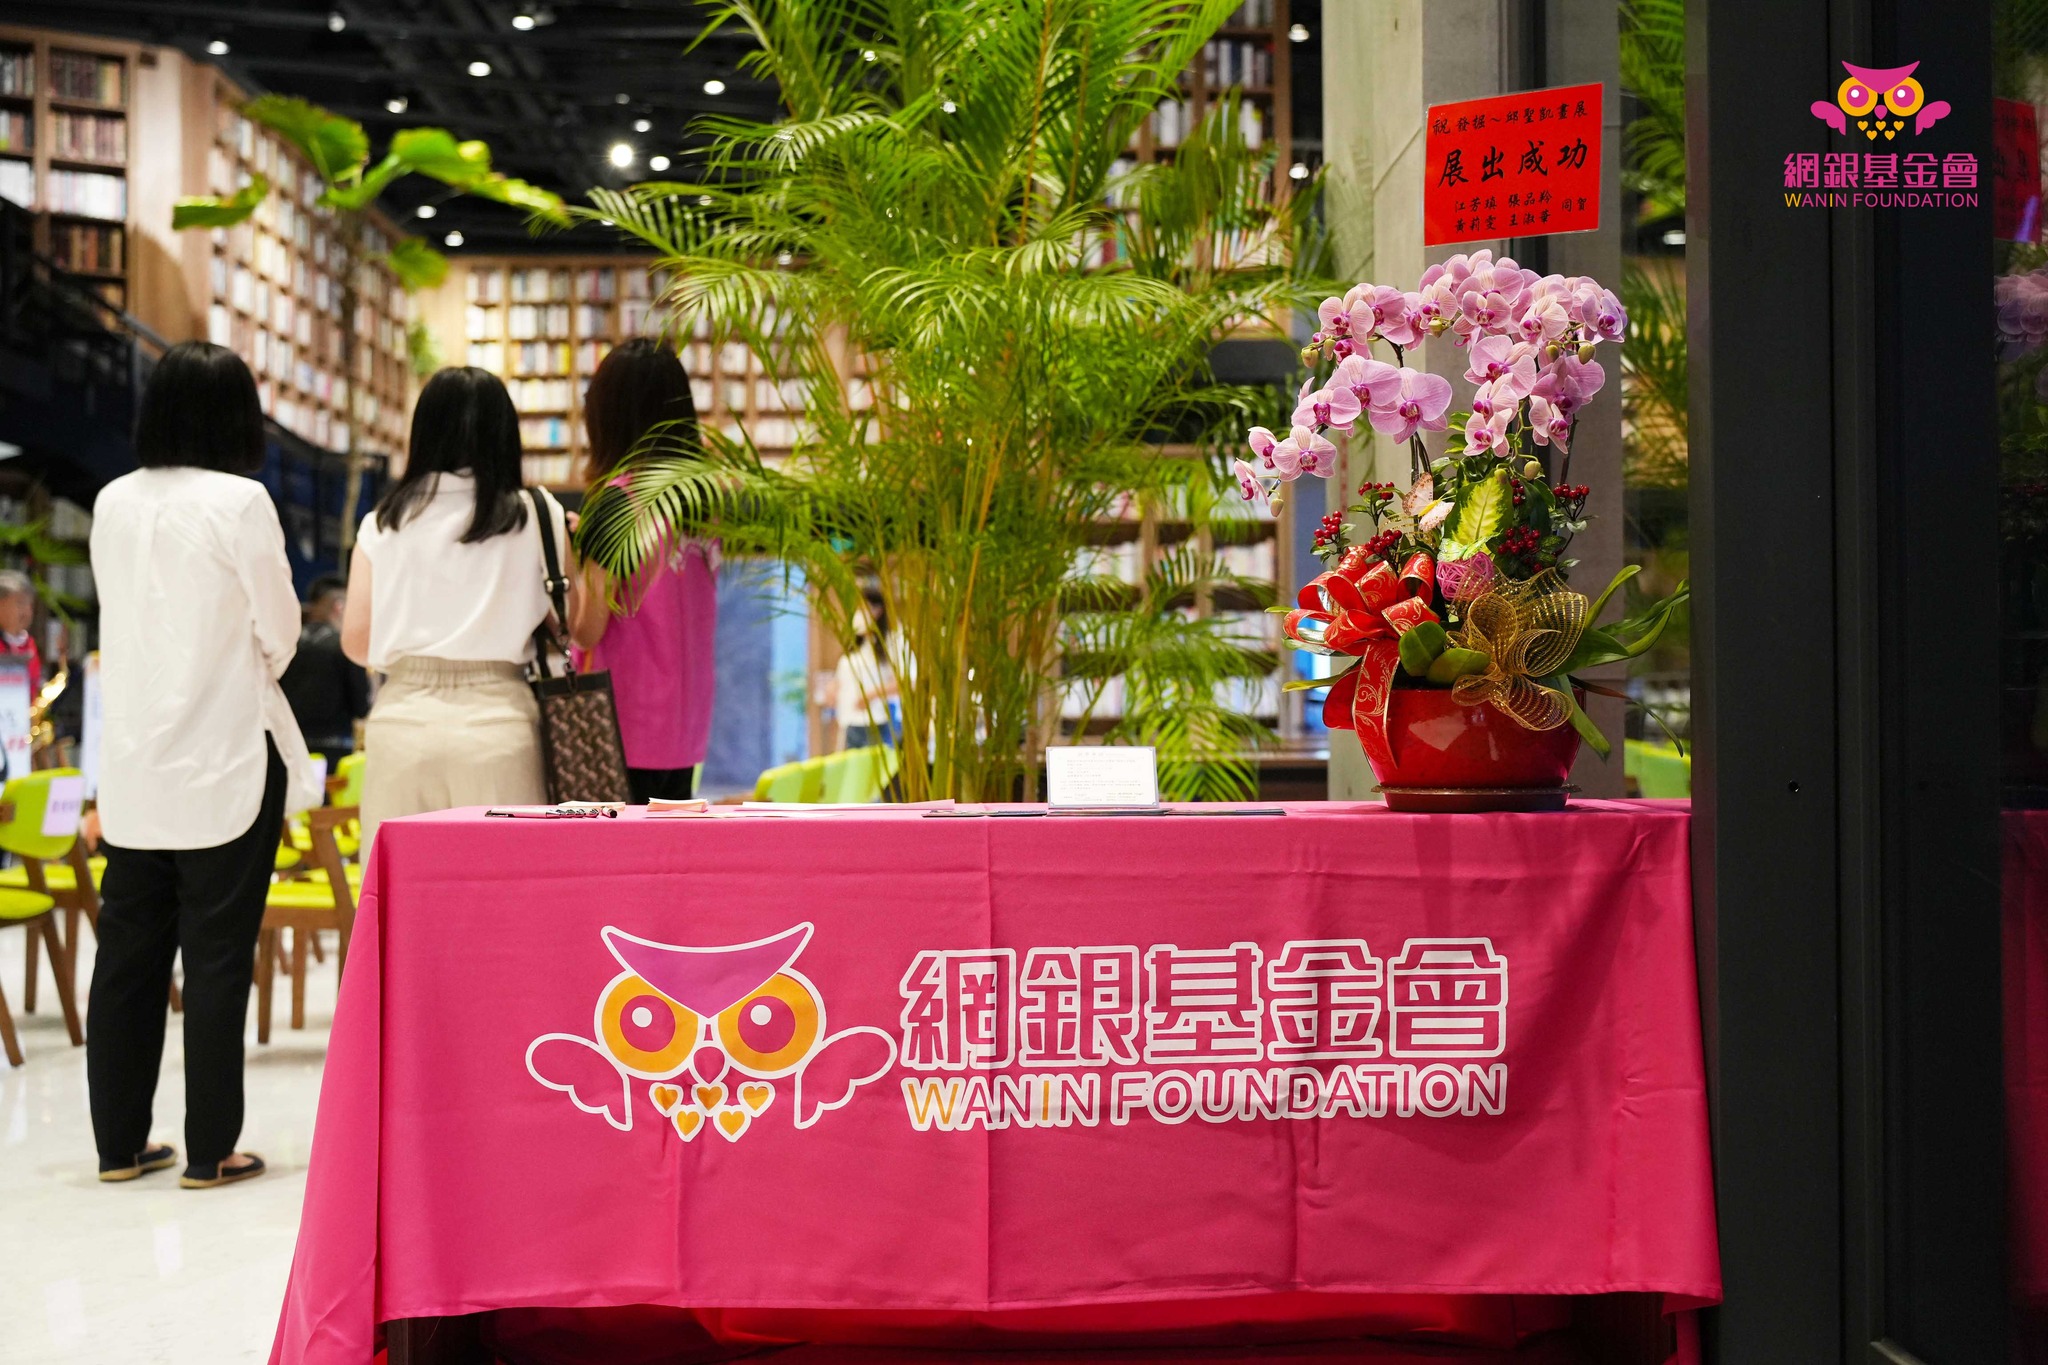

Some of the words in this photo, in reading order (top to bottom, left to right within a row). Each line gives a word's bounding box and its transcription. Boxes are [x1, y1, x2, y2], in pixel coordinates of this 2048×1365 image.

[1432, 119, 1451, 135] 祝
[1438, 138, 1588, 188] 展出成功
[1561, 197, 1587, 212] 同賀
[900, 938, 1508, 1069] 網銀基金會
[901, 1075, 1100, 1132] WANIN
[1110, 1064, 1509, 1125] FOUNDATION
